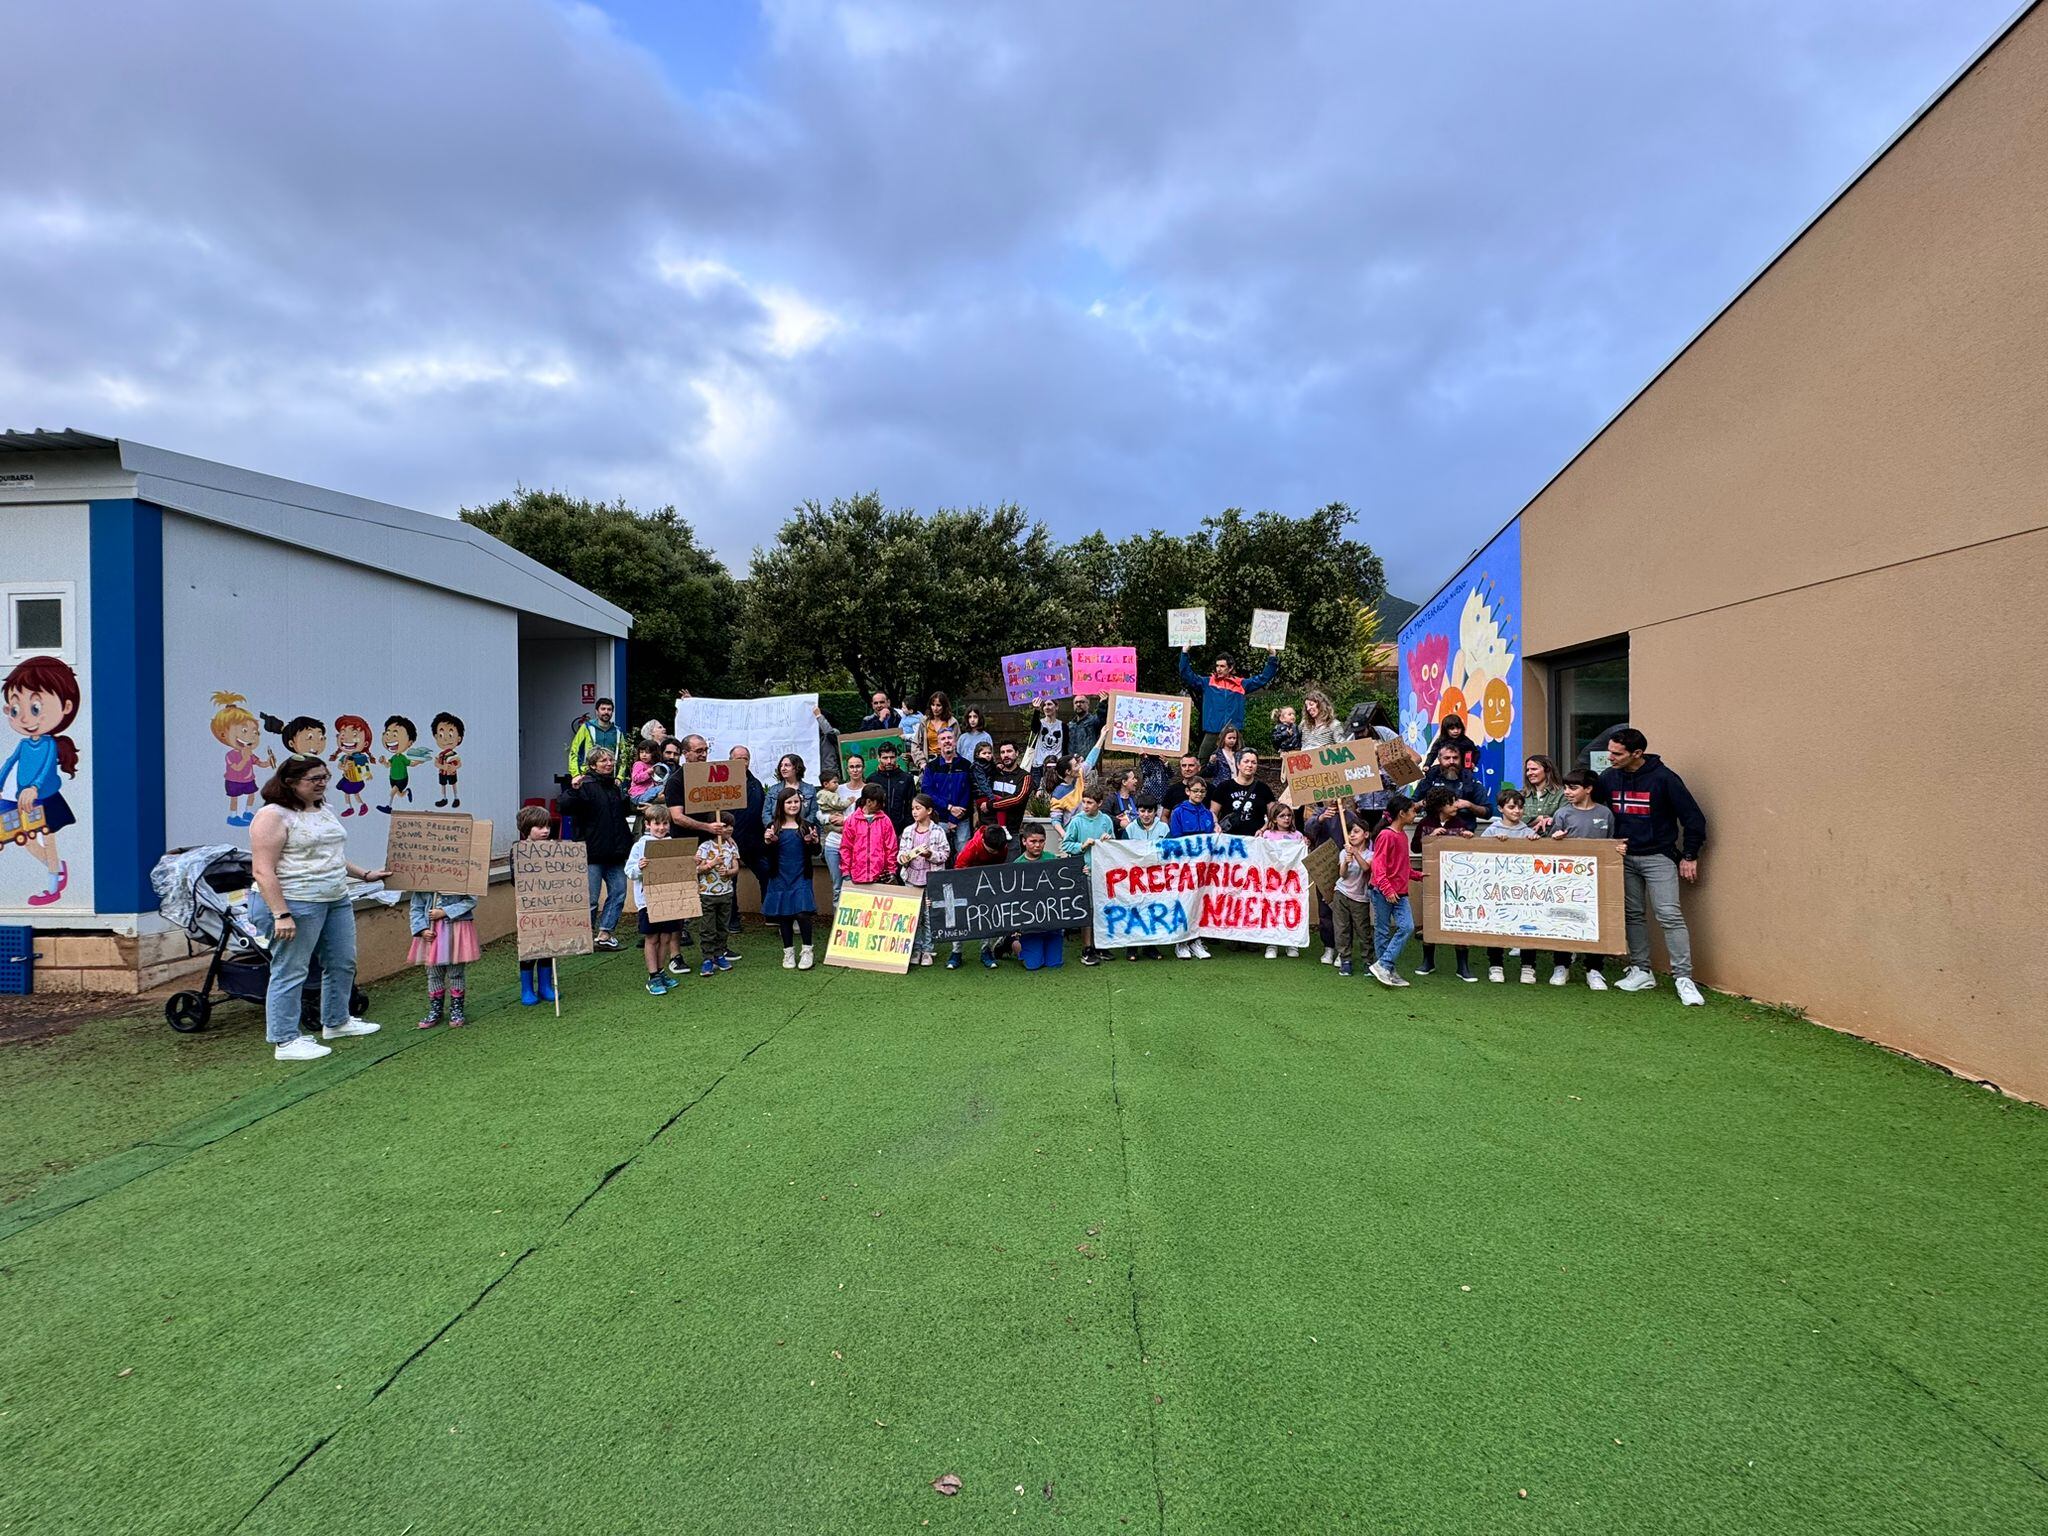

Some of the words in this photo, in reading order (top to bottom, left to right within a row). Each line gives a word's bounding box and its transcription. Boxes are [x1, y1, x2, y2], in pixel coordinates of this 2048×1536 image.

[1114, 720, 1176, 733] QUEREMOS
[1286, 753, 1312, 774] POR
[1318, 746, 1356, 766] UNA
[707, 764, 730, 783] NO
[1291, 771, 1340, 792] ESCUELA
[1344, 764, 1375, 782] RURAL
[1155, 835, 1248, 860] AULA
[517, 861, 543, 874] LOS
[408, 872, 431, 886] YA
[517, 878, 535, 892] EN
[538, 877, 583, 891] NUESTRO
[975, 866, 1076, 897] AULAS
[1105, 861, 1302, 899] PREFABRICADA
[872, 896, 894, 911] NO
[966, 894, 1088, 932] PROFESORES
[1444, 903, 1487, 920] LATA
[837, 907, 878, 929] TENEMOS
[1103, 899, 1188, 938] PARA
[1198, 893, 1302, 930] NUENO
[833, 929, 860, 949] PARA
